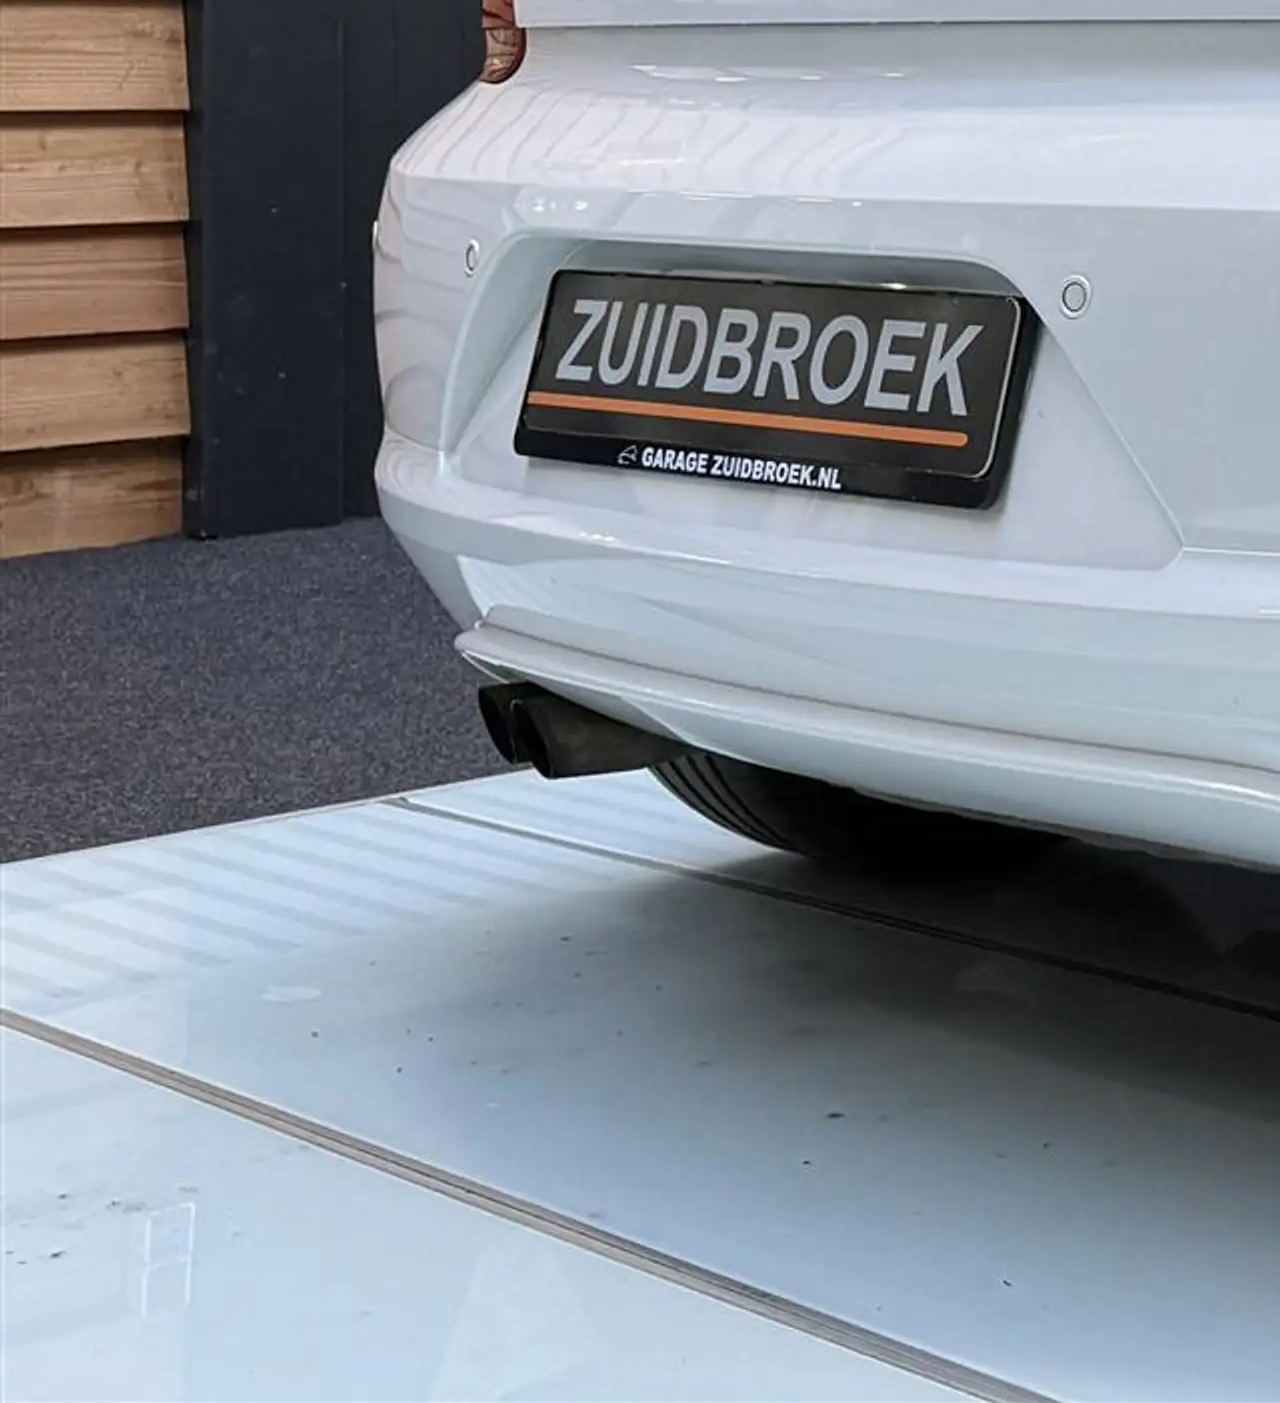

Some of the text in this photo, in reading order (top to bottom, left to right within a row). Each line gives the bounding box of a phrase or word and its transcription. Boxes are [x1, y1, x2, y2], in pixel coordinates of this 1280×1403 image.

[556, 300, 984, 416] ZUIDBROEK
[641, 446, 841, 490] GARAGE ZUIDBROEK.NL
